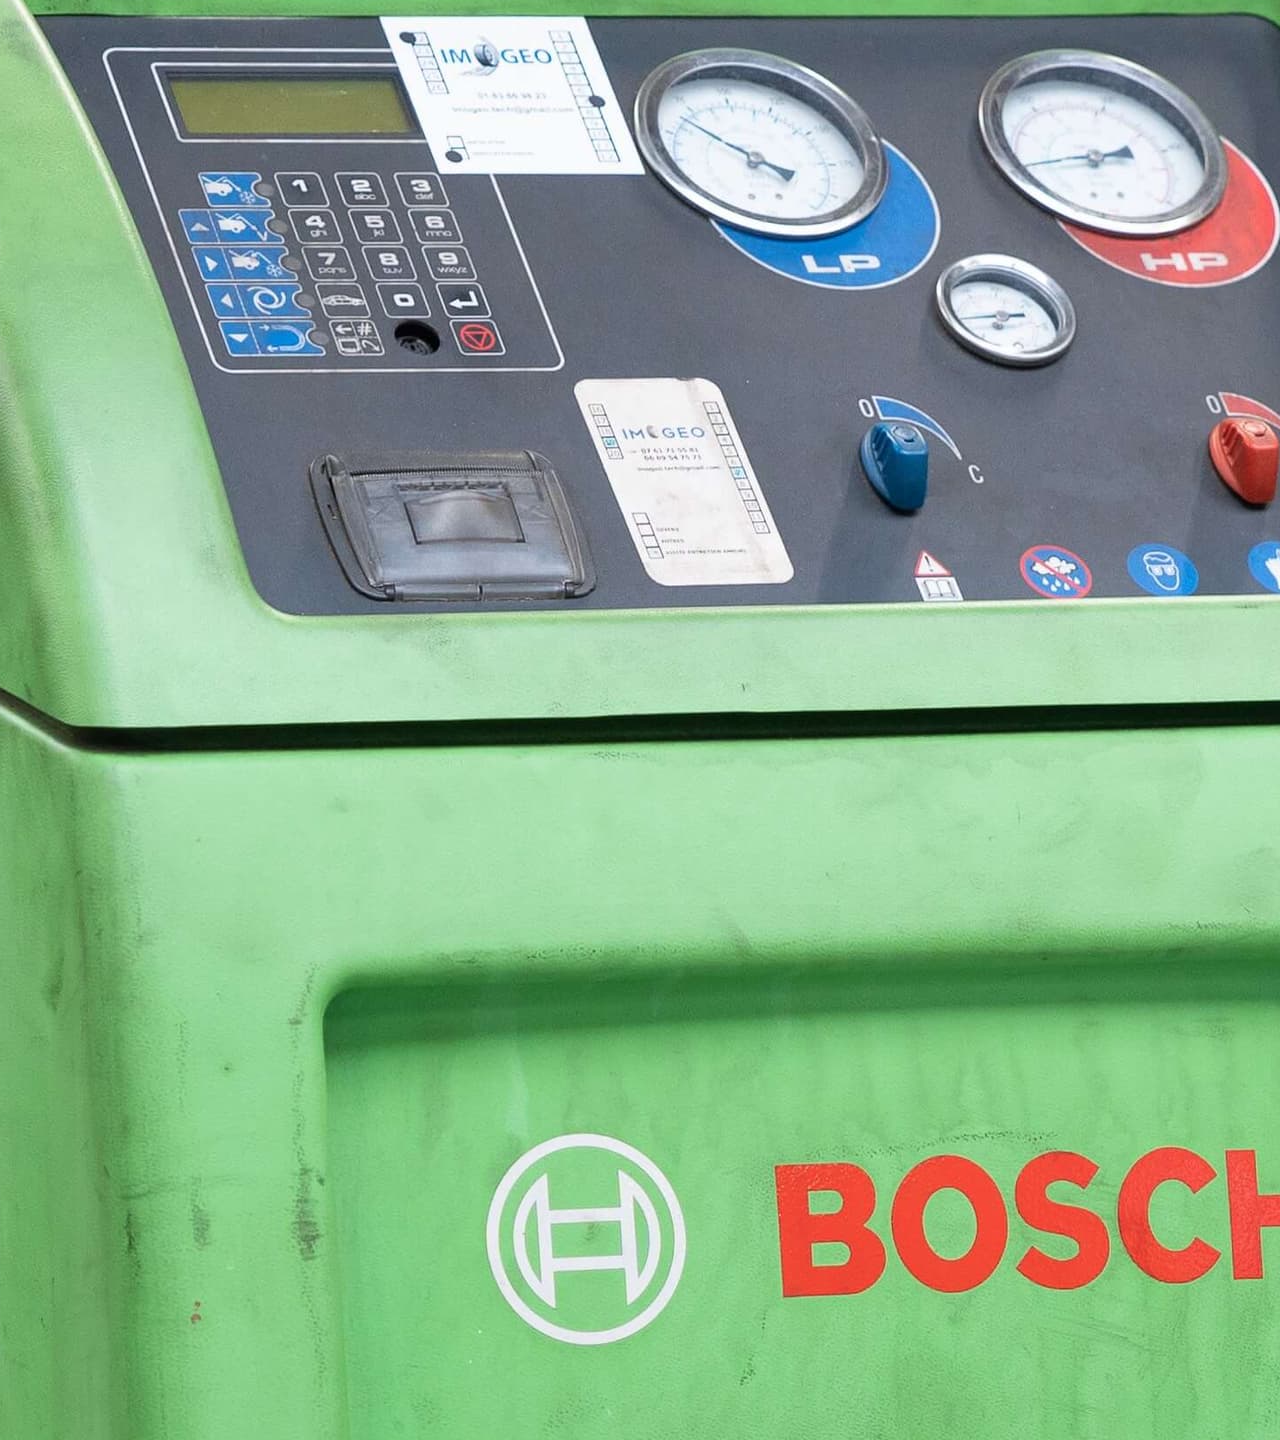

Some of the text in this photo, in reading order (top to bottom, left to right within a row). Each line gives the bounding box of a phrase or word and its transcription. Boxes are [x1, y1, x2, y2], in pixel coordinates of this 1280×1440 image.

[292, 179, 308, 192] 1
[351, 179, 372, 192] 2
[410, 179, 431, 192] 3
[354, 193, 376, 201] abc
[415, 193, 434, 201] def
[305, 215, 326, 228] 4
[364, 215, 385, 228] 5
[424, 216, 445, 229] 6
[310, 228, 328, 237] ghi
[318, 252, 336, 266] 7
[378, 252, 399, 266] 8
[438, 252, 459, 265] 9
[803, 253, 881, 274] LP
[1139, 252, 1229, 271] HP
[318, 266, 347, 275] pqrs
[383, 266, 403, 274] tuv
[436, 266, 468, 275] wxyz
[393, 293, 415, 307] 0
[968, 464, 984, 484] C
